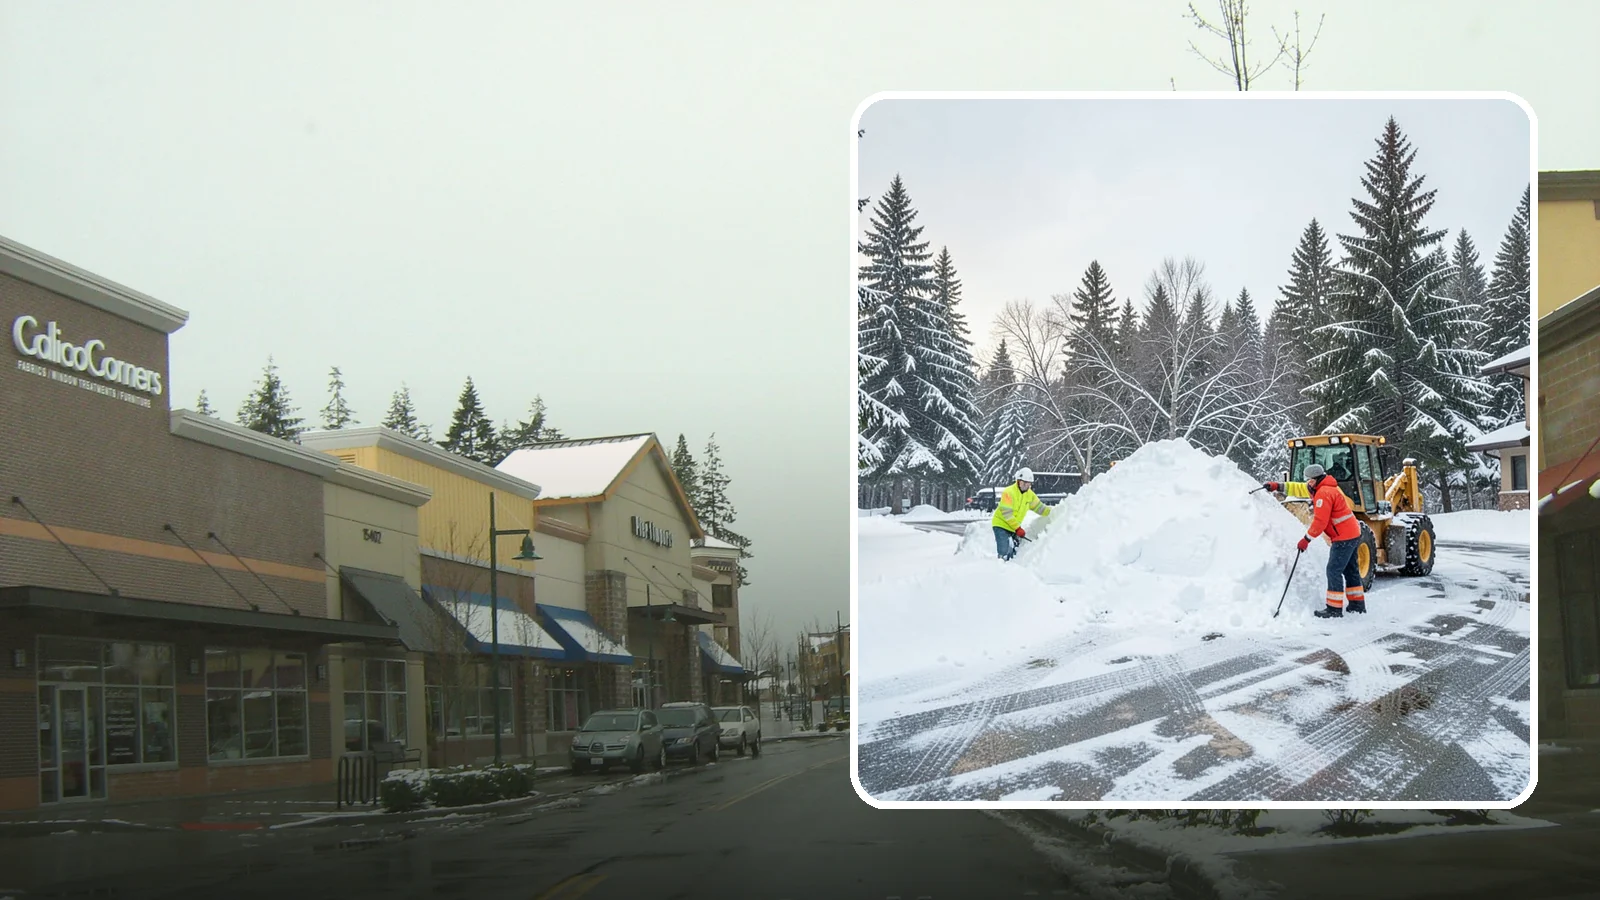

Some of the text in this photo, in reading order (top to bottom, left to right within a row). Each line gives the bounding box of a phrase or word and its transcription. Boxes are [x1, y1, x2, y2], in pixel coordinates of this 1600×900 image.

[17, 359, 152, 409] FABRICS WINDOW TREATMENTS FURNITURE
